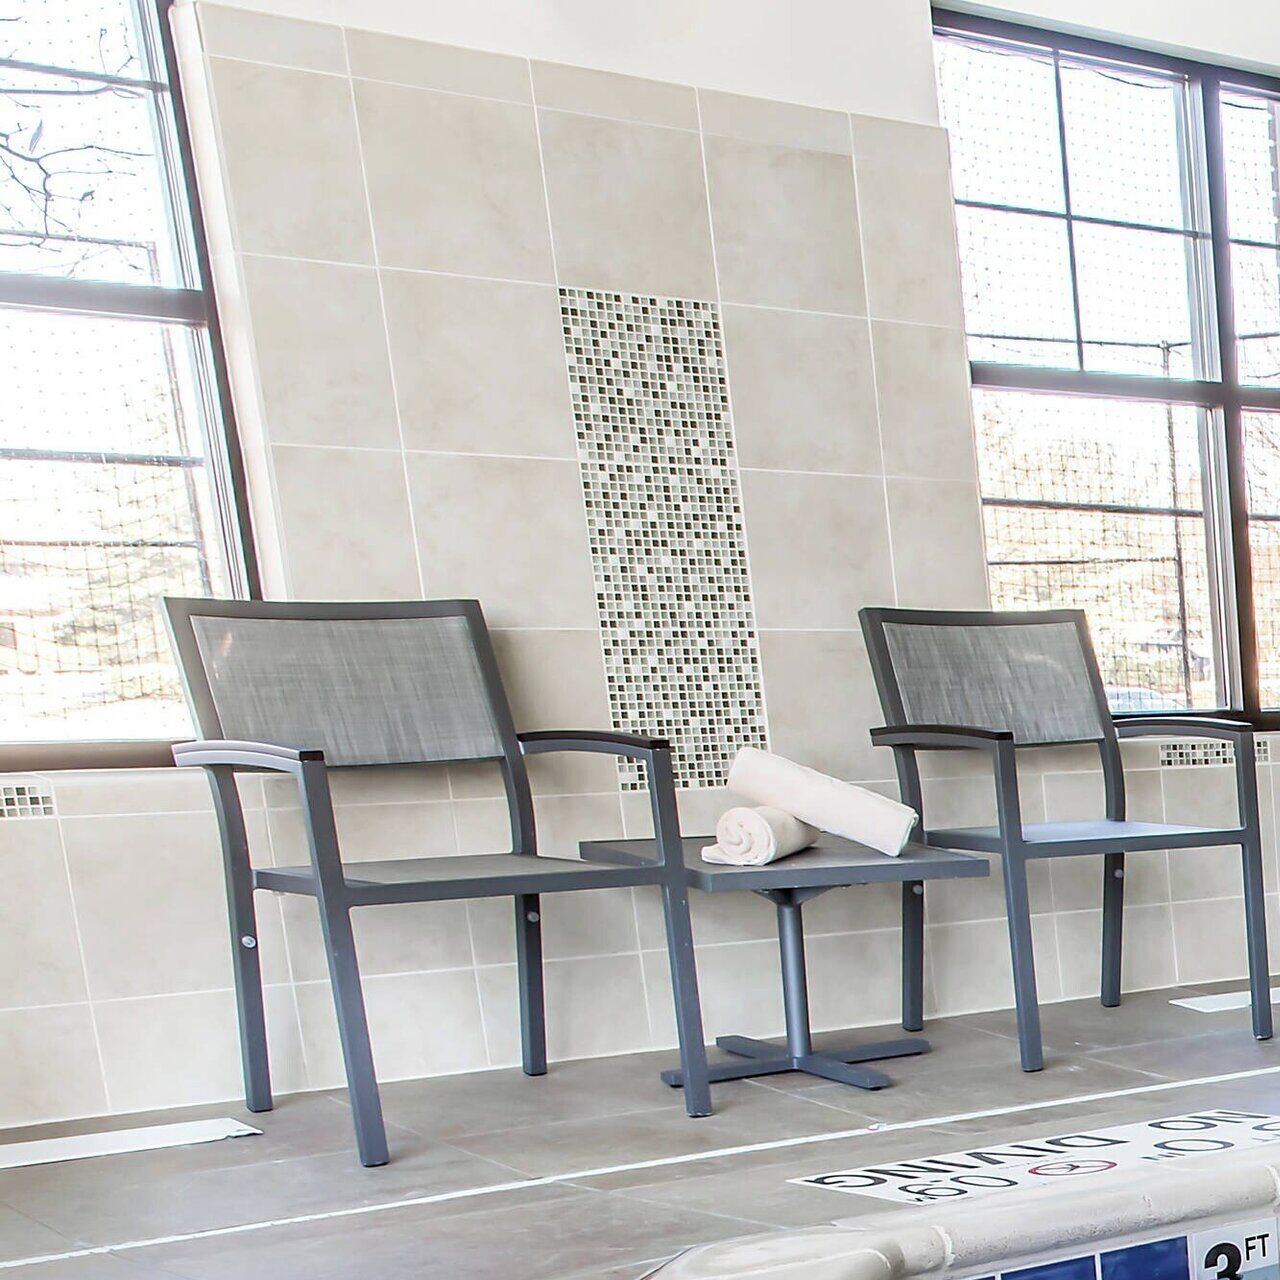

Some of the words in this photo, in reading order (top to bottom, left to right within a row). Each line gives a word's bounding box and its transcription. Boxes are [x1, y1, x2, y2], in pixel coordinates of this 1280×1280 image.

[1147, 1110, 1271, 1131] NO
[803, 1134, 1131, 1188] DIVING
[1244, 1233, 1270, 1262] FT
